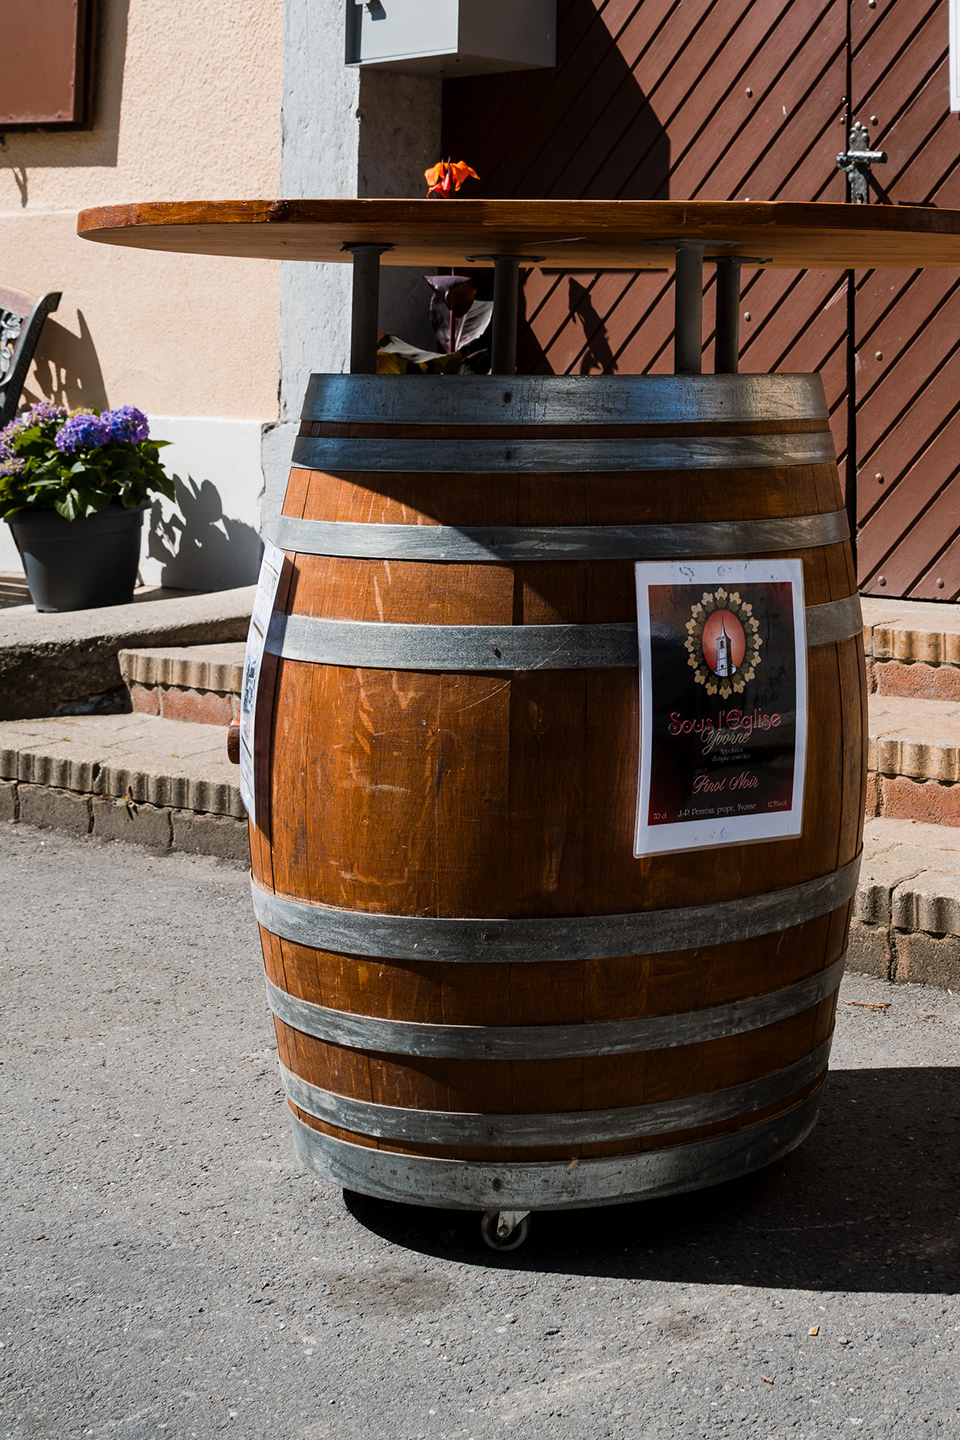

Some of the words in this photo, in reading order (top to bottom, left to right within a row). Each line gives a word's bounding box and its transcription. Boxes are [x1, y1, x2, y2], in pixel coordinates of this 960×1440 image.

[668, 712, 714, 735] Sous
[700, 725, 750, 755] Yvorne
[692, 774, 727, 794] Pinot
[728, 771, 760, 791] Noir
